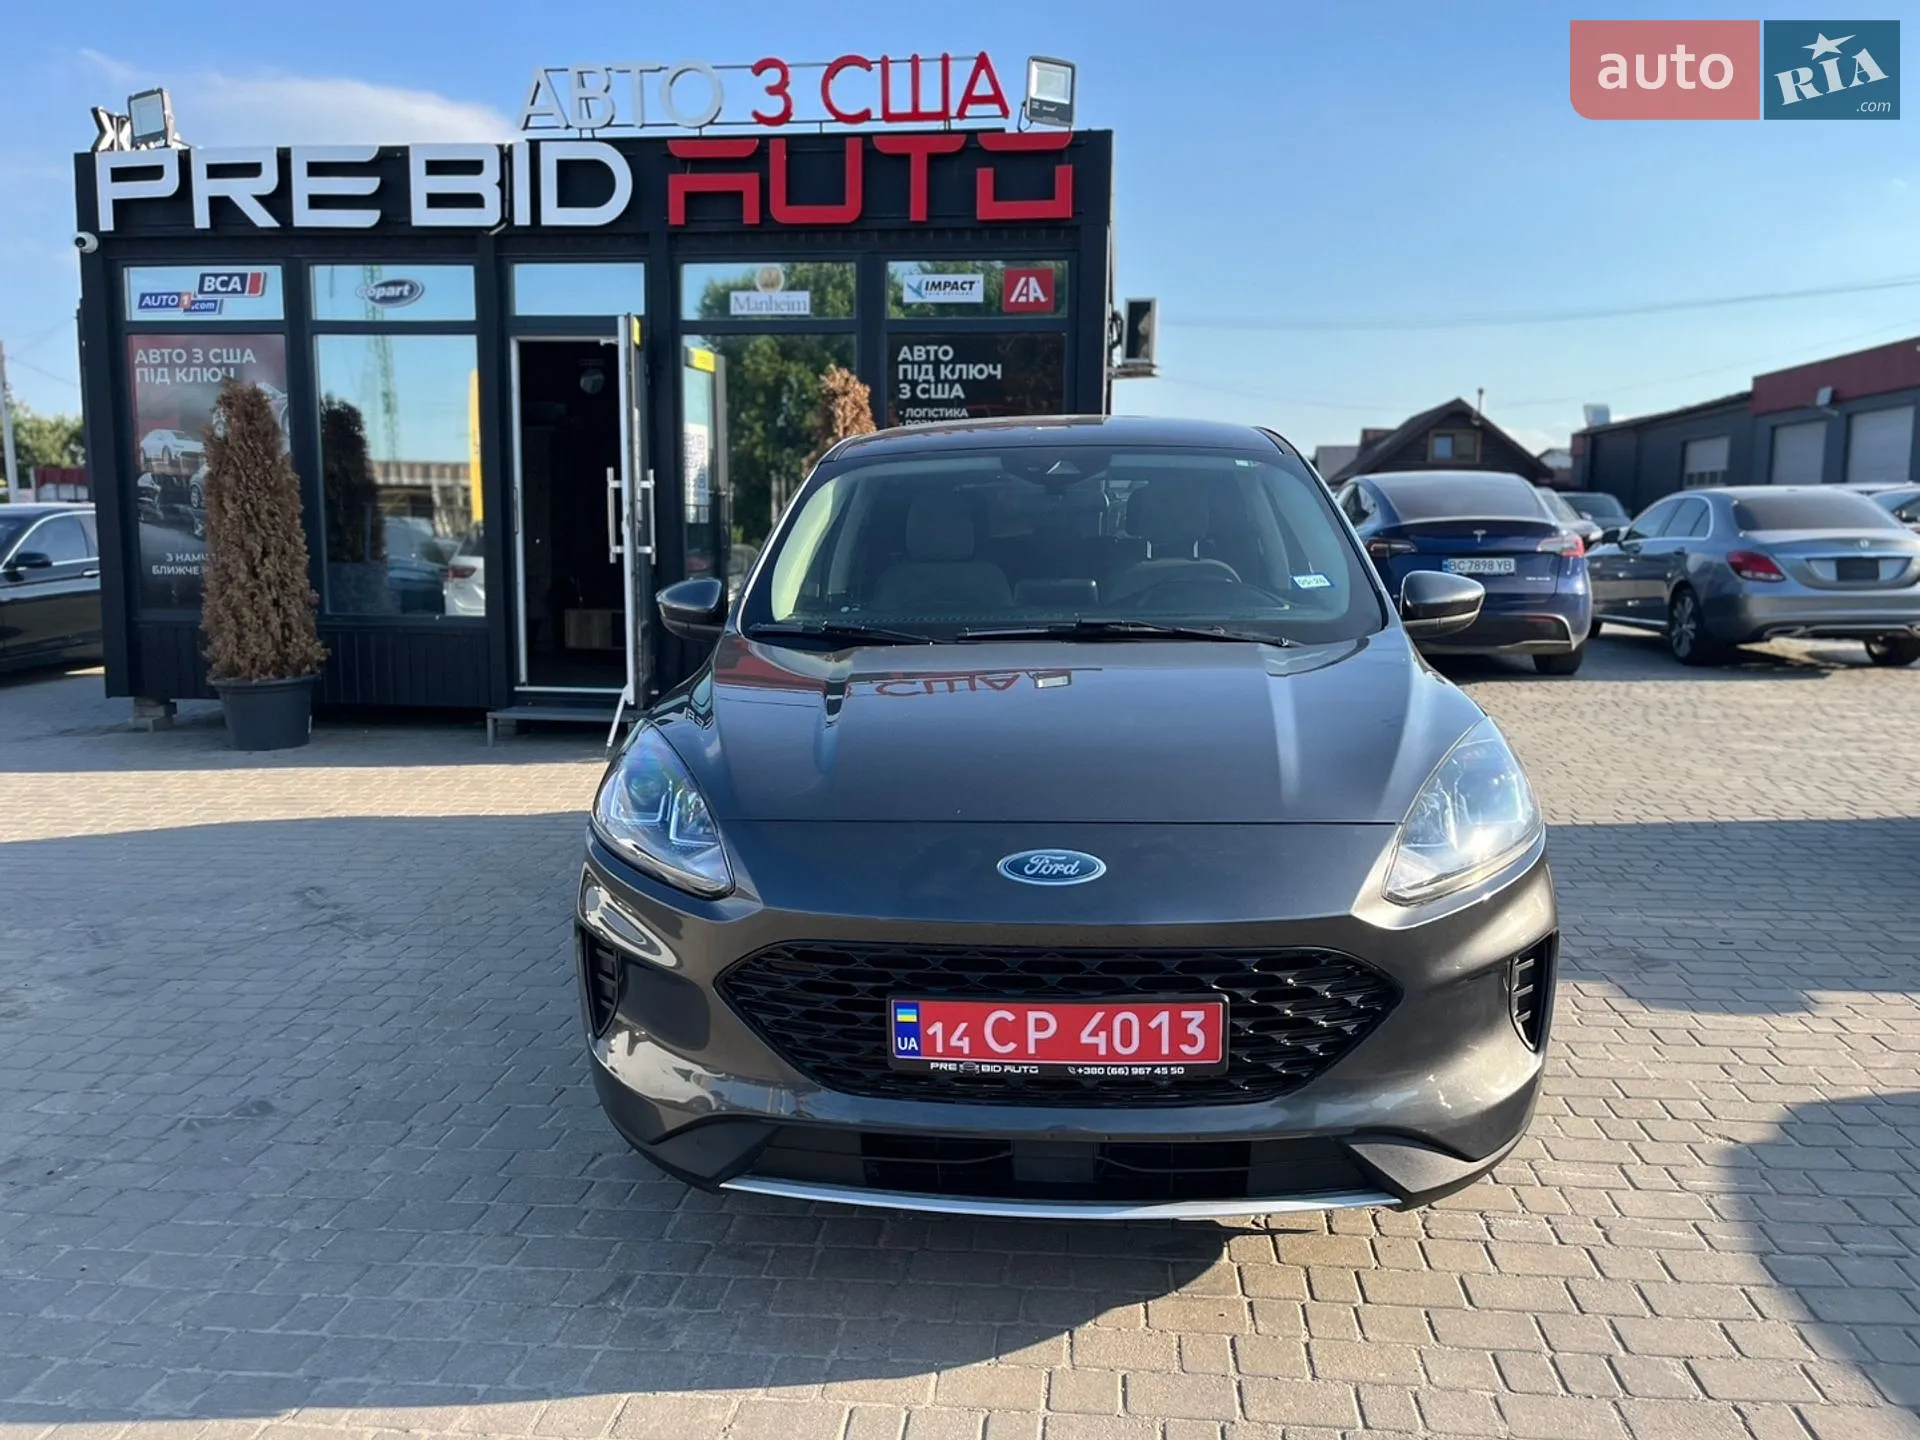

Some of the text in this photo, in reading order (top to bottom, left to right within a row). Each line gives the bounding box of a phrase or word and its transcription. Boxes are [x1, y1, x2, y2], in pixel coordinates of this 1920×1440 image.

[517, 62, 724, 130] АВТО
[820, 51, 1011, 126] США
[667, 132, 1074, 226] AUTO
[203, 275, 243, 293] BCA
[925, 280, 976, 291] IMPACT
[734, 295, 807, 313] Manheim
[134, 348, 187, 364] АВТО
[209, 348, 256, 364] США
[897, 345, 954, 361] АВТО
[135, 367, 170, 384] ПІД
[898, 363, 1002, 382] ПІД КЛЮЧ
[916, 383, 965, 399] США
[905, 407, 969, 418] ЛОГІСТИКА
[152, 564, 200, 575] БЛИЖЧЕ
[1468, 560, 1494, 571] 7898
[1024, 854, 1080, 875] Ford
[926, 1009, 1206, 1056] 14 CP 4013
[897, 1036, 919, 1051] UA
